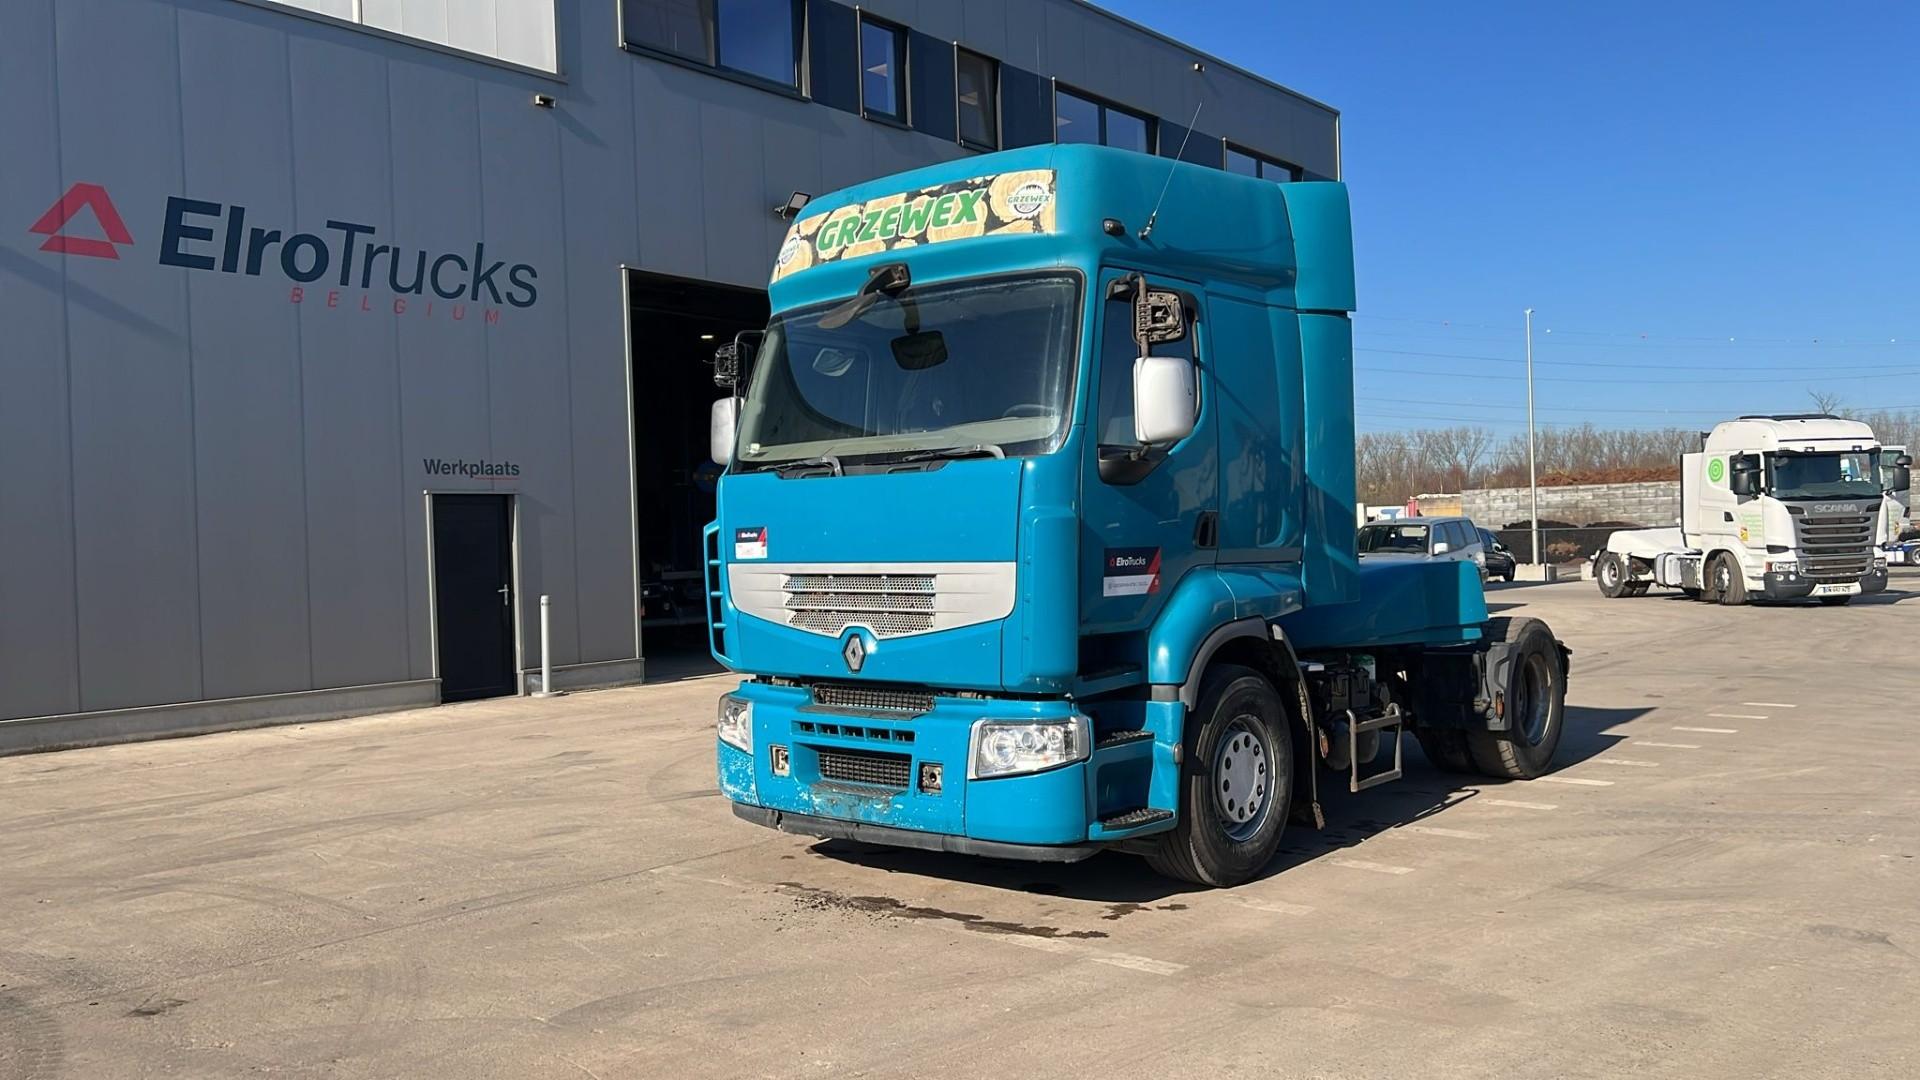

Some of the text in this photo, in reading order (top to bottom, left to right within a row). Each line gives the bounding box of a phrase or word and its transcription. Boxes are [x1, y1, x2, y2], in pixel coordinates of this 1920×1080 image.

[1007, 194, 1050, 204] GRZEWEX
[816, 188, 988, 251] GRZEWEX
[160, 196, 538, 308] ElroTrucks
[290, 286, 501, 324] BELGIUM
[423, 458, 520, 478] Werkplaats
[1814, 503, 1858, 513] SCANIA
